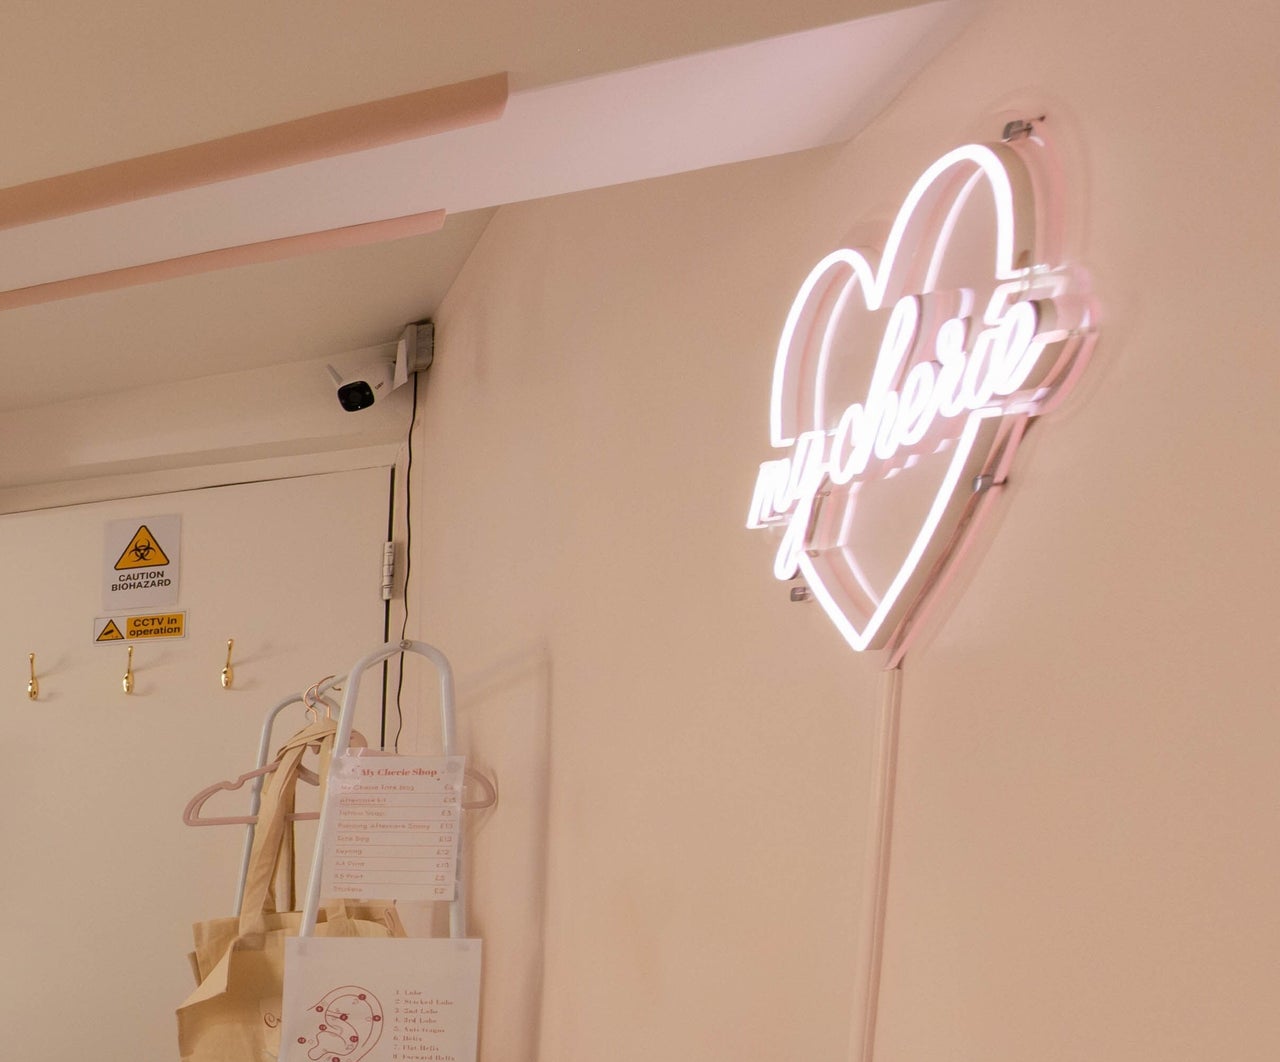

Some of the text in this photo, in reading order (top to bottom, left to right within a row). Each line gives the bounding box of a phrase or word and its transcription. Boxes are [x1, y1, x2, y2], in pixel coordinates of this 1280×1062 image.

[118, 571, 165, 582] CAUTION
[111, 578, 171, 592] BIOHAZARD
[133, 617, 164, 627] CCTV
[129, 625, 181, 637] operation
[411, 768, 438, 778] Shop
